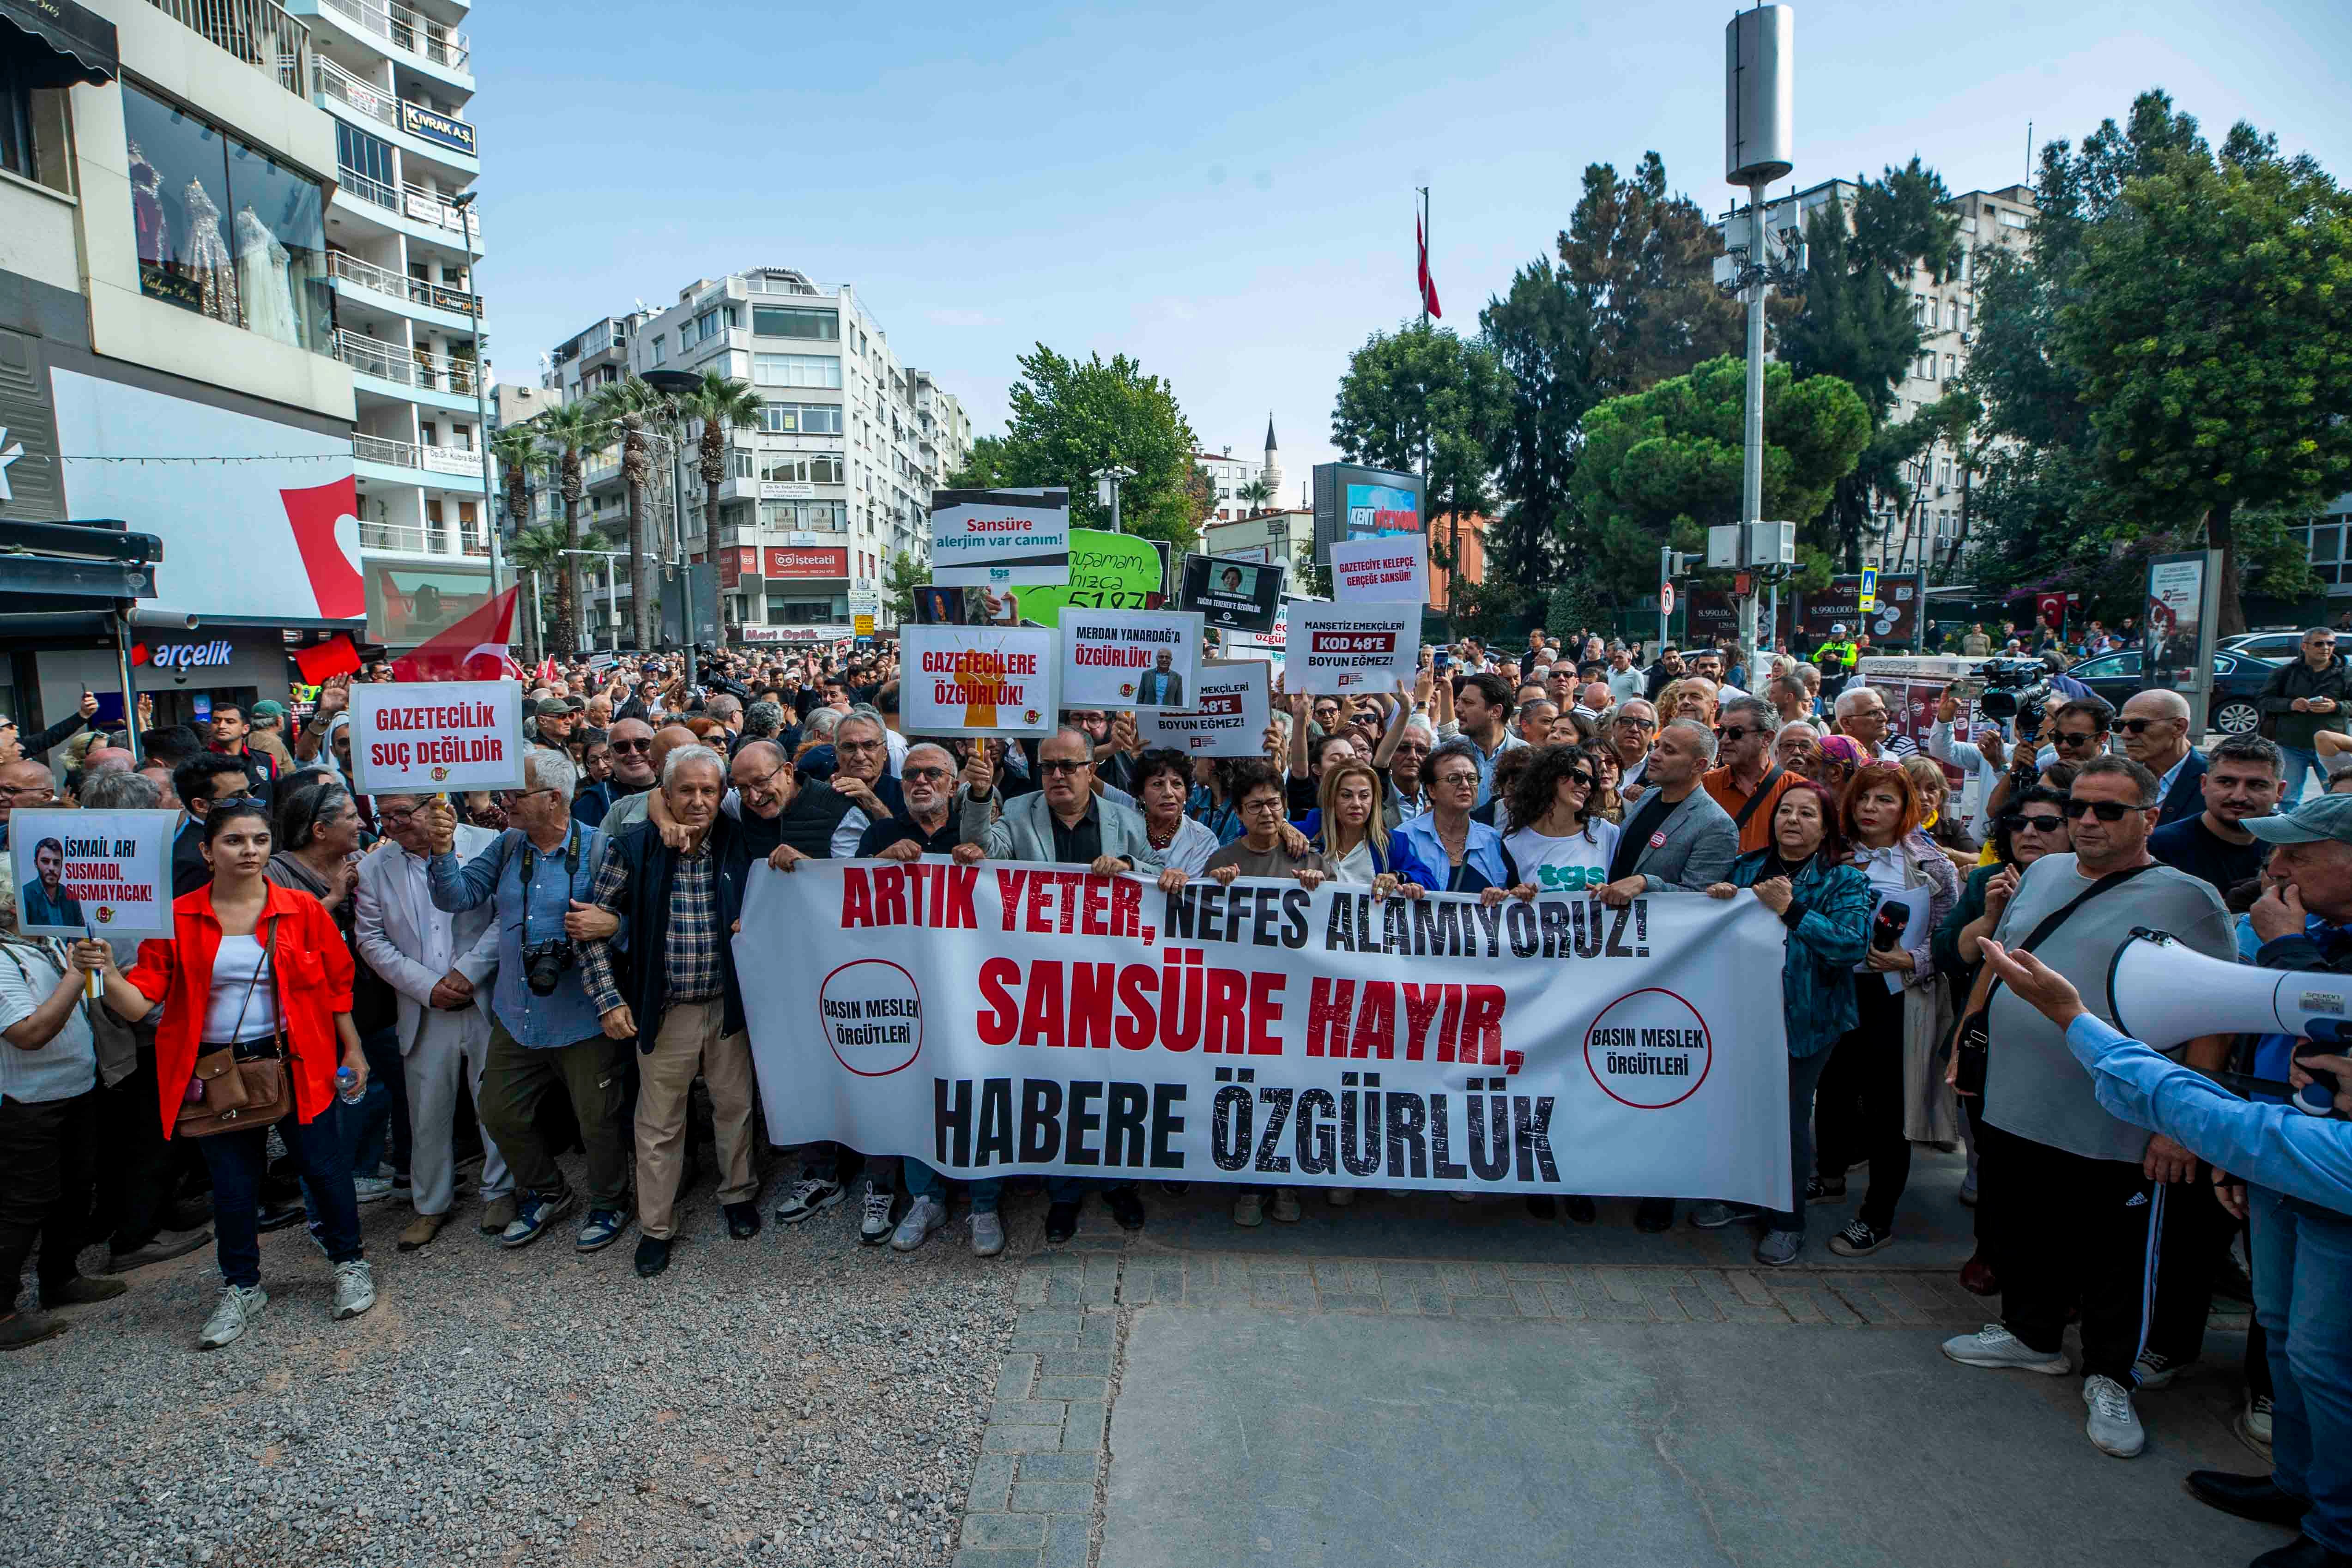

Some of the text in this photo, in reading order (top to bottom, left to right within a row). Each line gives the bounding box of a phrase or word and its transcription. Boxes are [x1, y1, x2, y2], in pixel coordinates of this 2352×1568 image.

[406, 107, 452, 135] KIVRAK
[967, 517, 1033, 532] Sansüre
[937, 533, 1063, 549] alerjim var canım!
[990, 568, 1010, 578] tgs
[1339, 556, 1417, 573] GAZETECİYE KELEPÇE,
[1347, 570, 1412, 588] GERÇEĞE SANSÜR!
[1197, 596, 1261, 613] TUĞBA TEKEREK'E ÖZGÜRLÜK
[782, 629, 818, 641] Optik
[1076, 626, 1180, 643] MERDAN YANARDAĞ'A
[1305, 620, 1405, 632] MANŞETİZ EMEKÇİLERİ
[1319, 636, 1386, 650] KOD 48'E
[153, 640, 233, 672] arçelik
[923, 649, 1037, 675] GAZETECİLERE
[1075, 643, 1152, 668] ÖZGÜRLÜK!
[1308, 654, 1394, 667] BOYUN EĞMEZ!
[934, 679, 1024, 706] ÖZGÜRLÜK!
[1200, 681, 1249, 695] MEKÇİLERİ
[375, 701, 496, 731] GAZETECİLİK
[1158, 717, 1245, 730] BOYUN EĞMEZ!
[371, 735, 503, 773] SUÇ DEĞİLDİR
[65, 835, 136, 858] İSMAİL ARI
[569, 836, 578, 856] Nikon
[65, 863, 124, 882] SUSMADI,
[1537, 864, 1606, 891] tgs
[66, 884, 153, 902] SUSMAYACAK!
[840, 863, 1650, 959] ARTIK YETER, NEFES ALAMIYORUZ!
[823, 998, 919, 1019] BASIN MESLEK
[977, 947, 1287, 1055] SANSÜRE
[835, 1022, 911, 1046] ÖRGÜTLERİ
[1306, 976, 1524, 1075] HAYIR,
[1591, 1028, 1704, 1048] BASIN MESLEK
[1607, 1051, 1689, 1076] ÖRGÜTLERİ
[934, 1066, 1561, 1182] HABERE ÖZGÜRLÜK
